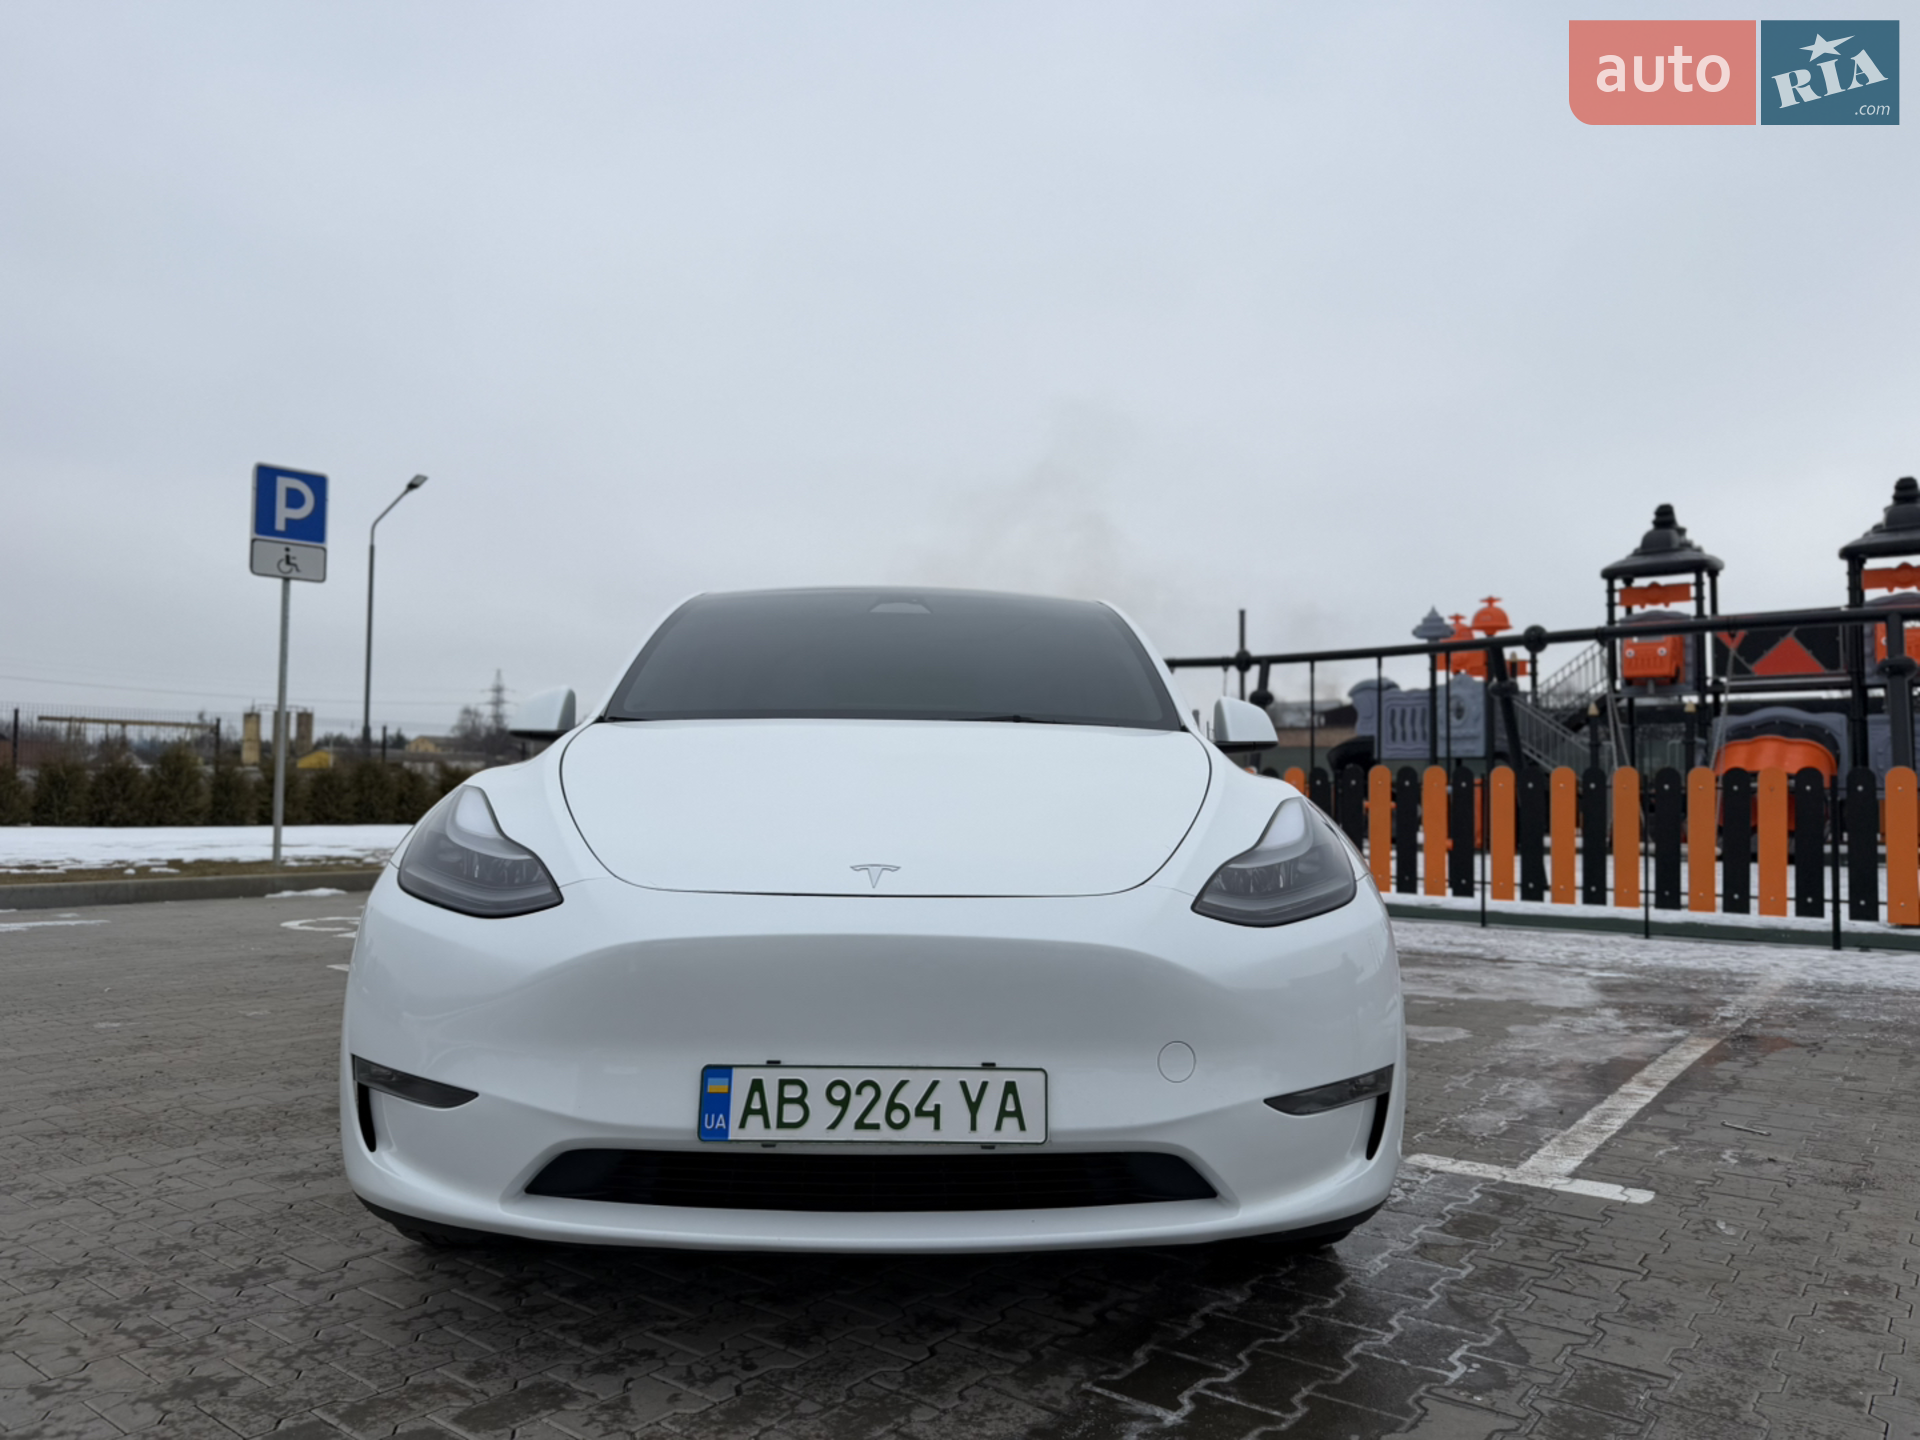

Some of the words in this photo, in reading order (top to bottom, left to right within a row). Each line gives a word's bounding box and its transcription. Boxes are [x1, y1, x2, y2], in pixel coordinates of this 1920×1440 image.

[275, 475, 315, 532] P
[704, 1113, 727, 1130] UA
[738, 1078, 811, 1130] AB
[825, 1079, 941, 1131] 9264
[959, 1080, 1027, 1132] YA
